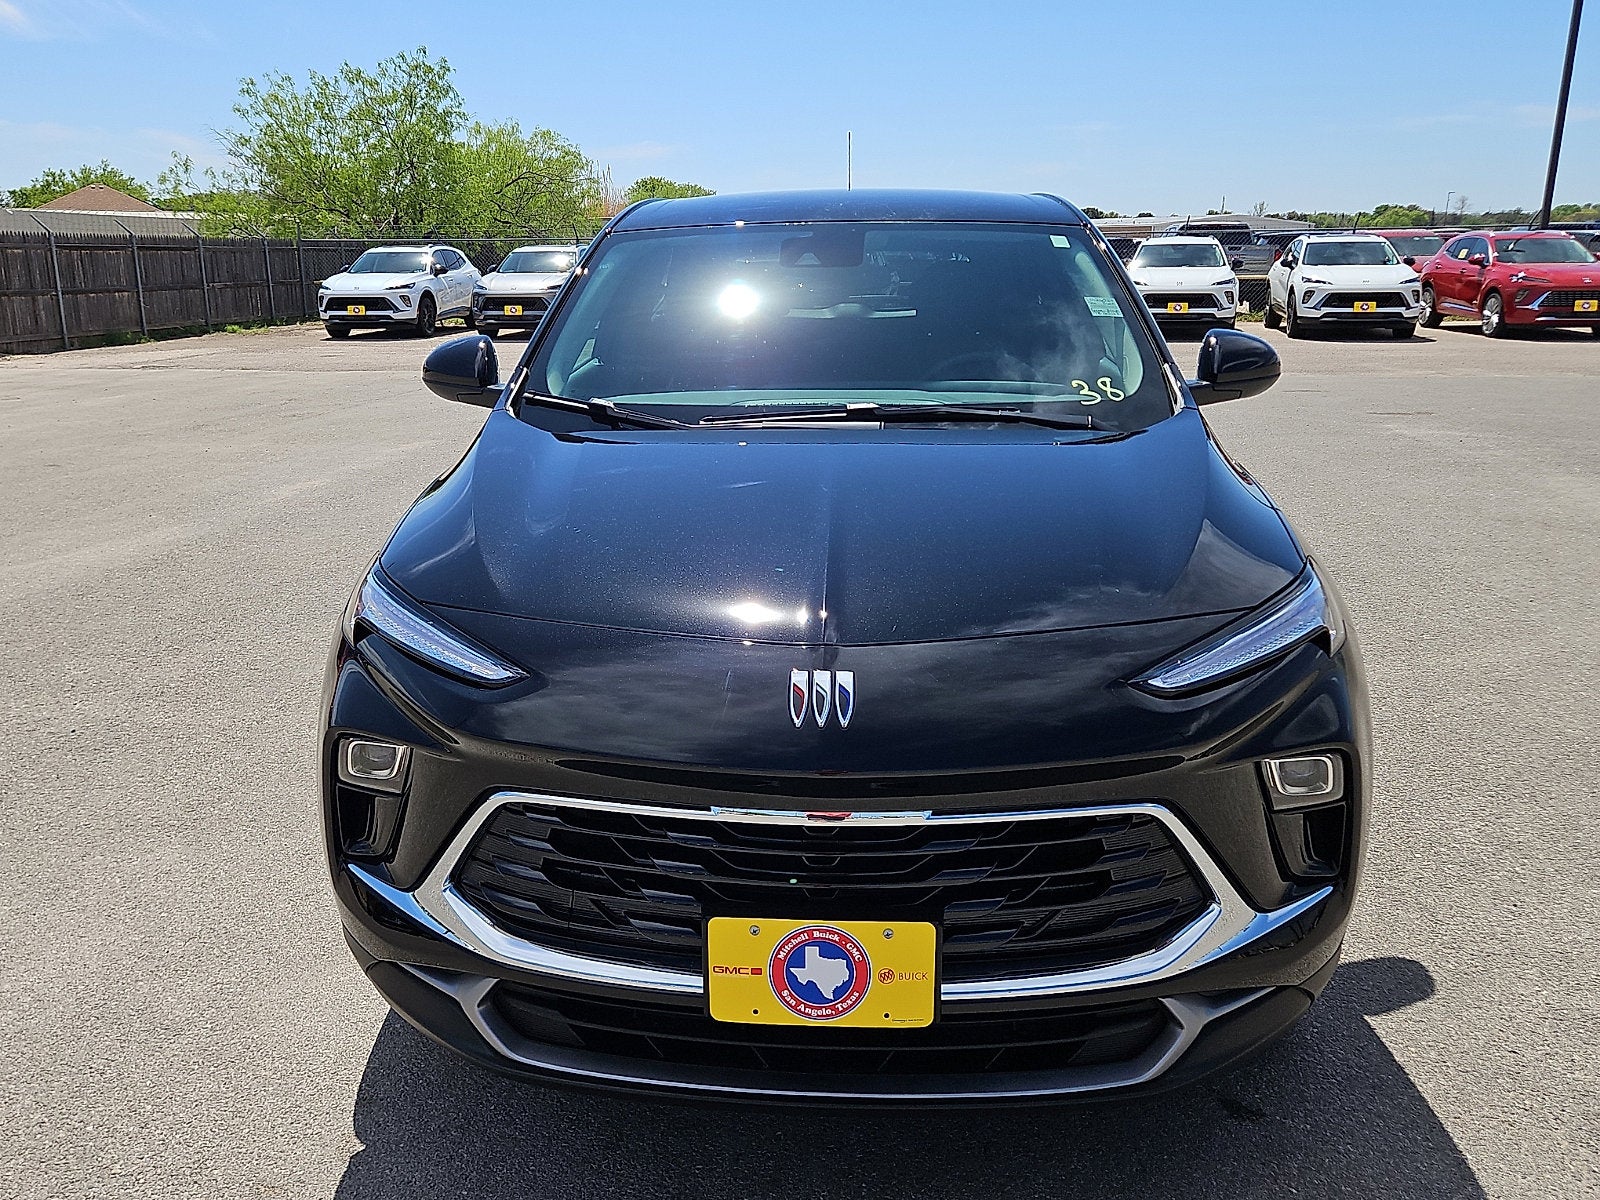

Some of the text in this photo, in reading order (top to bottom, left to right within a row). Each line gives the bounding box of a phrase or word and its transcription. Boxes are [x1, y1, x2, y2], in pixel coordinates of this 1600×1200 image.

[1071, 376, 1125, 405] 38
[777, 932, 809, 960] Mitchell
[812, 931, 840, 942] Buick
[846, 943, 863, 963] GMC
[712, 965, 750, 975] GMC
[898, 971, 929, 981] BUICK
[781, 989, 860, 1016] San Angelo, Texas
